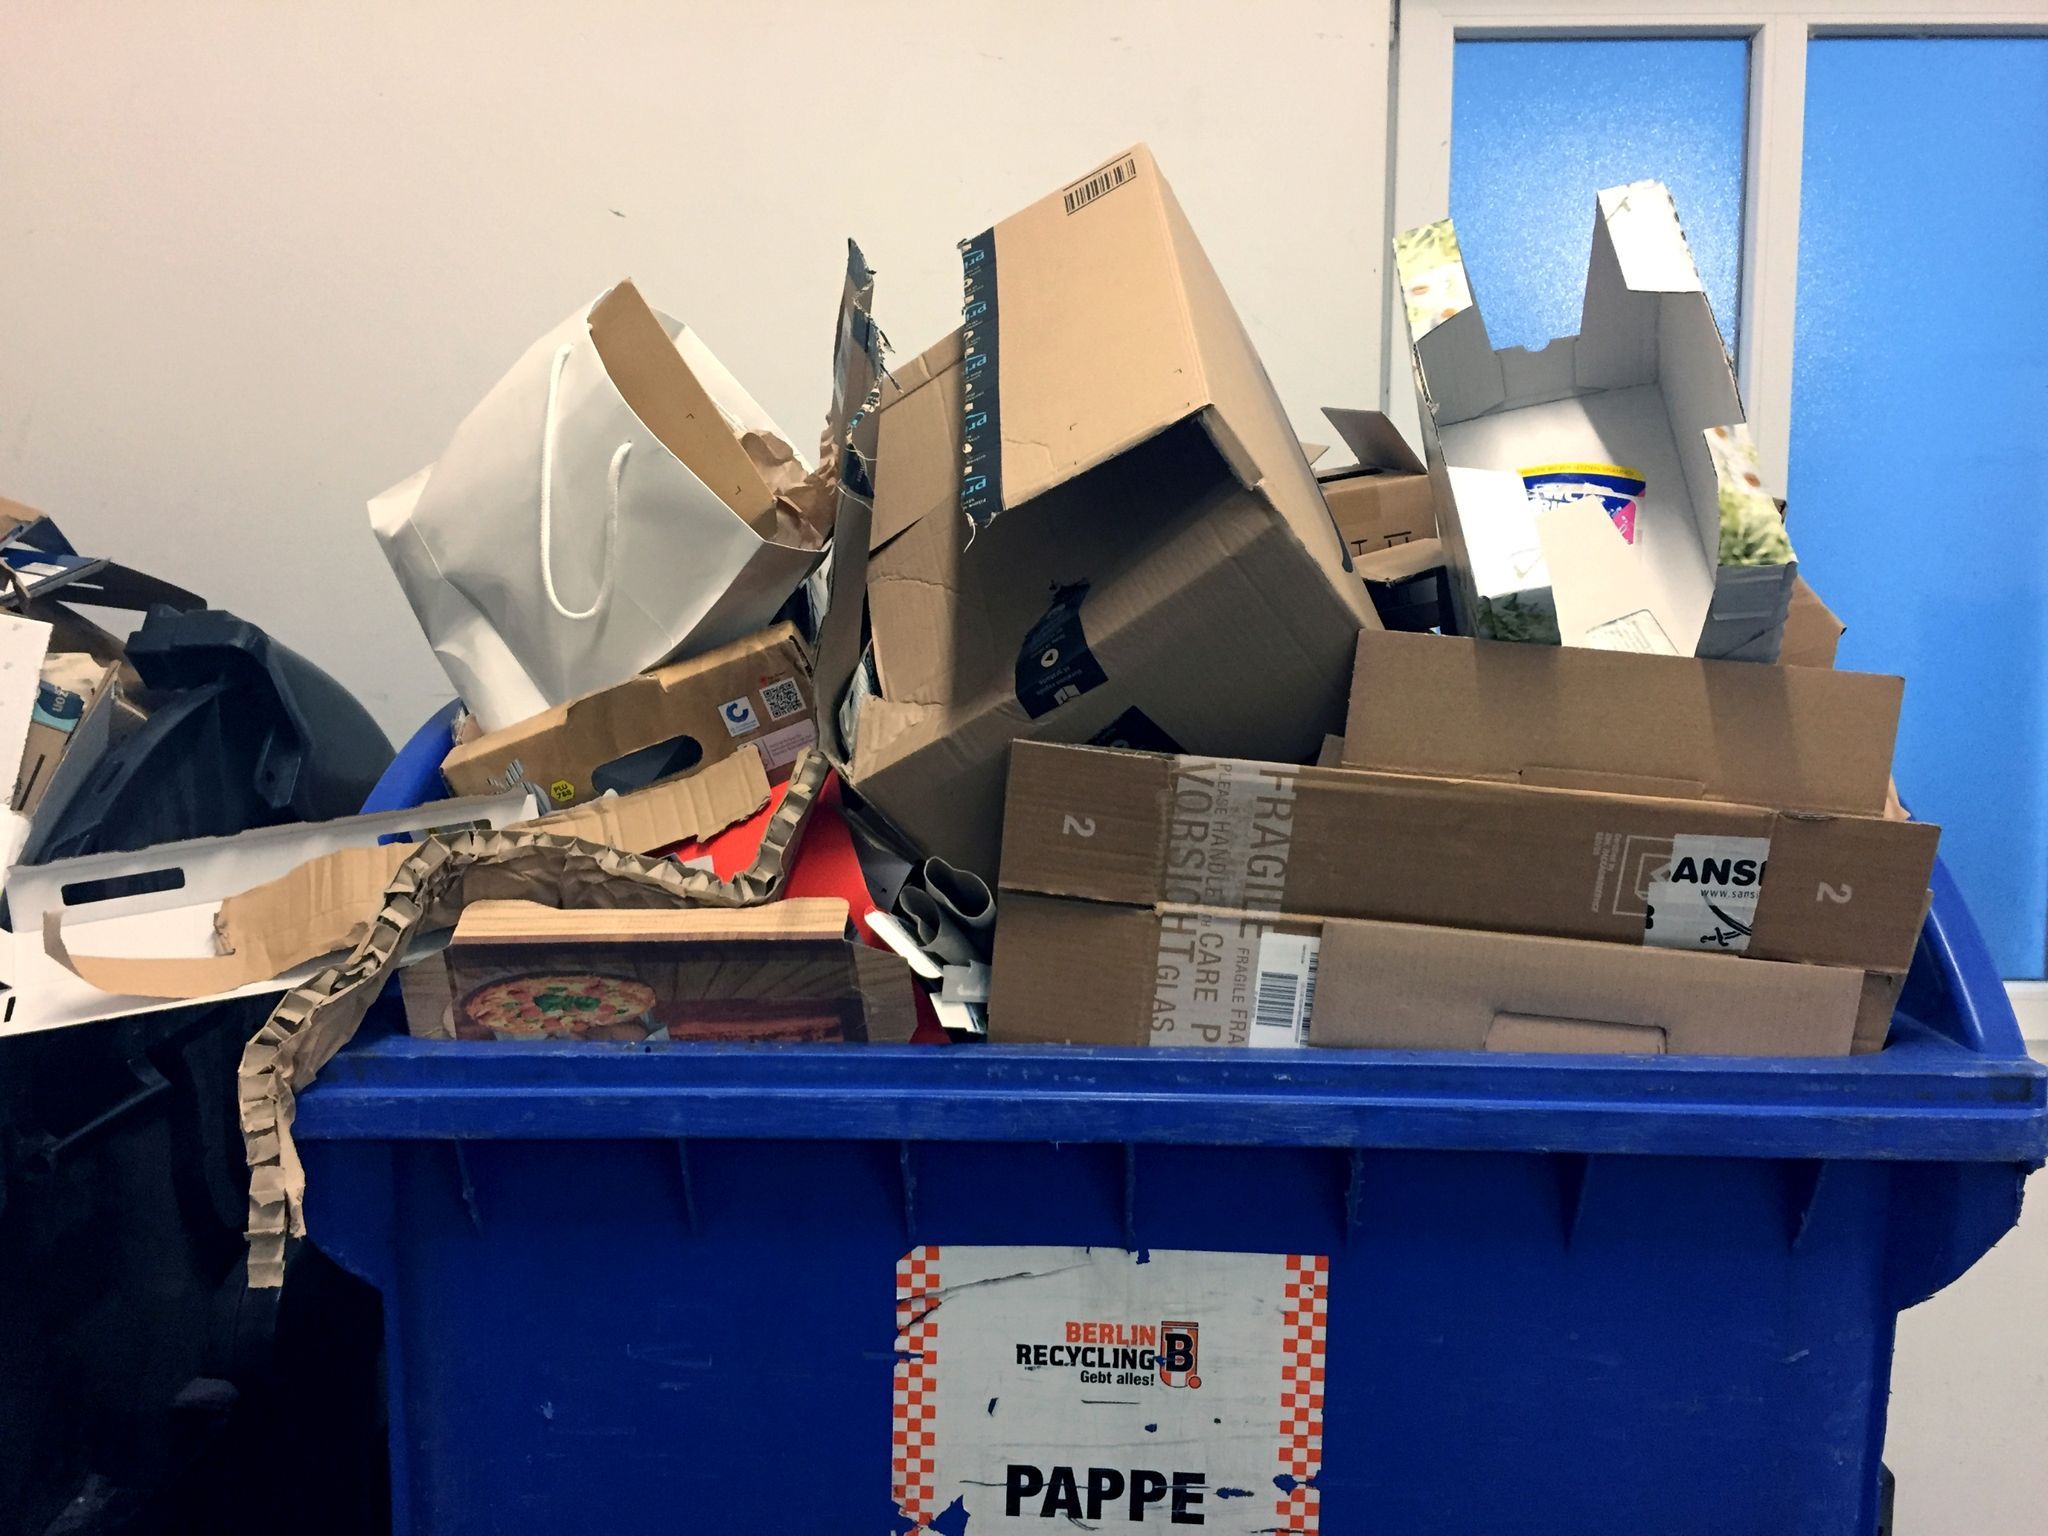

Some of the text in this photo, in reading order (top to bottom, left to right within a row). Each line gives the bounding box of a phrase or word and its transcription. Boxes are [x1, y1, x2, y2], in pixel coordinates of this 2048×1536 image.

[1214, 763, 1233, 815] PLEASE
[1062, 814, 1096, 839] 2
[1239, 769, 1300, 938] FRAGILE
[1204, 821, 1231, 898] HANDLE
[1816, 881, 1853, 905] 2
[1194, 932, 1224, 1003] CARE
[1232, 947, 1250, 1003] FRAGILE
[1152, 964, 1181, 1032] GLAS
[1016, 1343, 1155, 1370] RECYCLING
[1065, 1321, 1156, 1346] BERLIN
[1080, 1371, 1155, 1386] Gebt alles!
[1005, 1464, 1206, 1525] PAPPE
